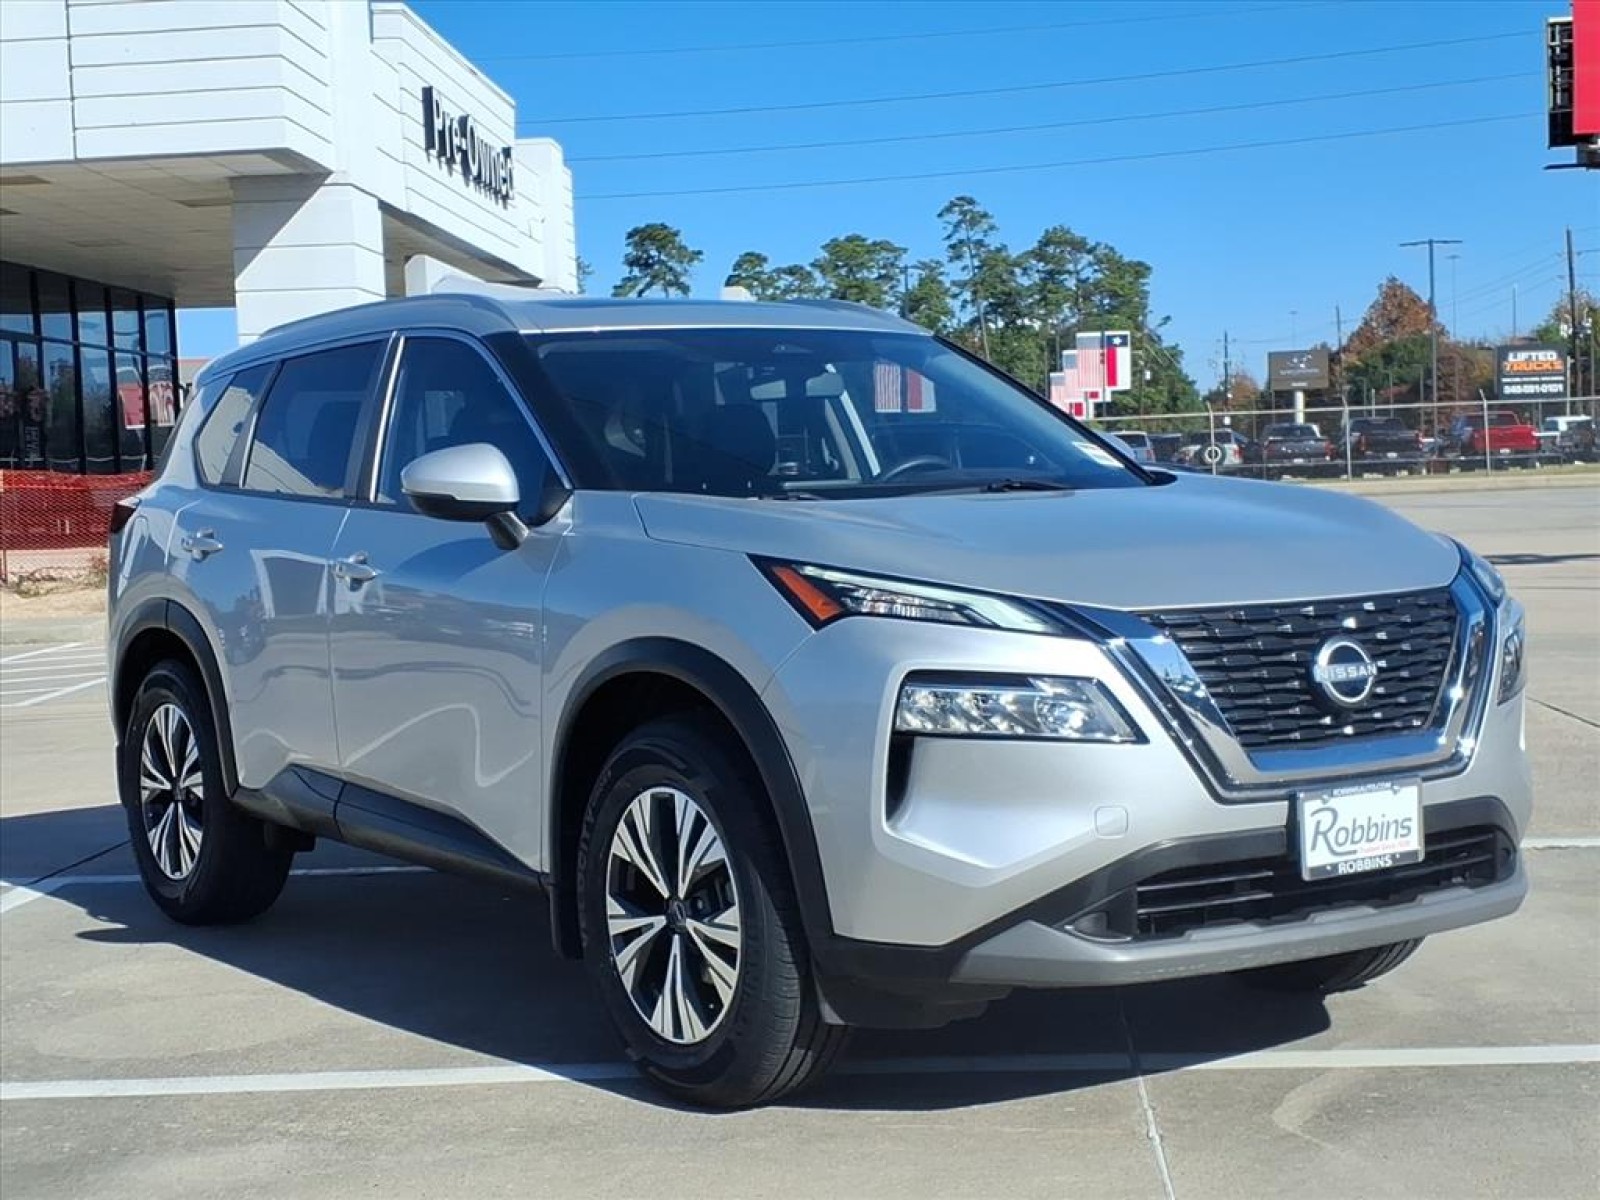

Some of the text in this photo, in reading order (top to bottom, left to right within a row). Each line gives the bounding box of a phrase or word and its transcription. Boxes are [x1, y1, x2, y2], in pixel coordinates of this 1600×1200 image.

[421, 86, 514, 201] Pre-Owned
[1508, 350, 1557, 361] LIFTED
[1314, 663, 1377, 682] NISSAN
[1310, 807, 1412, 856] Robbins
[1338, 854, 1393, 875] ROBBINS
